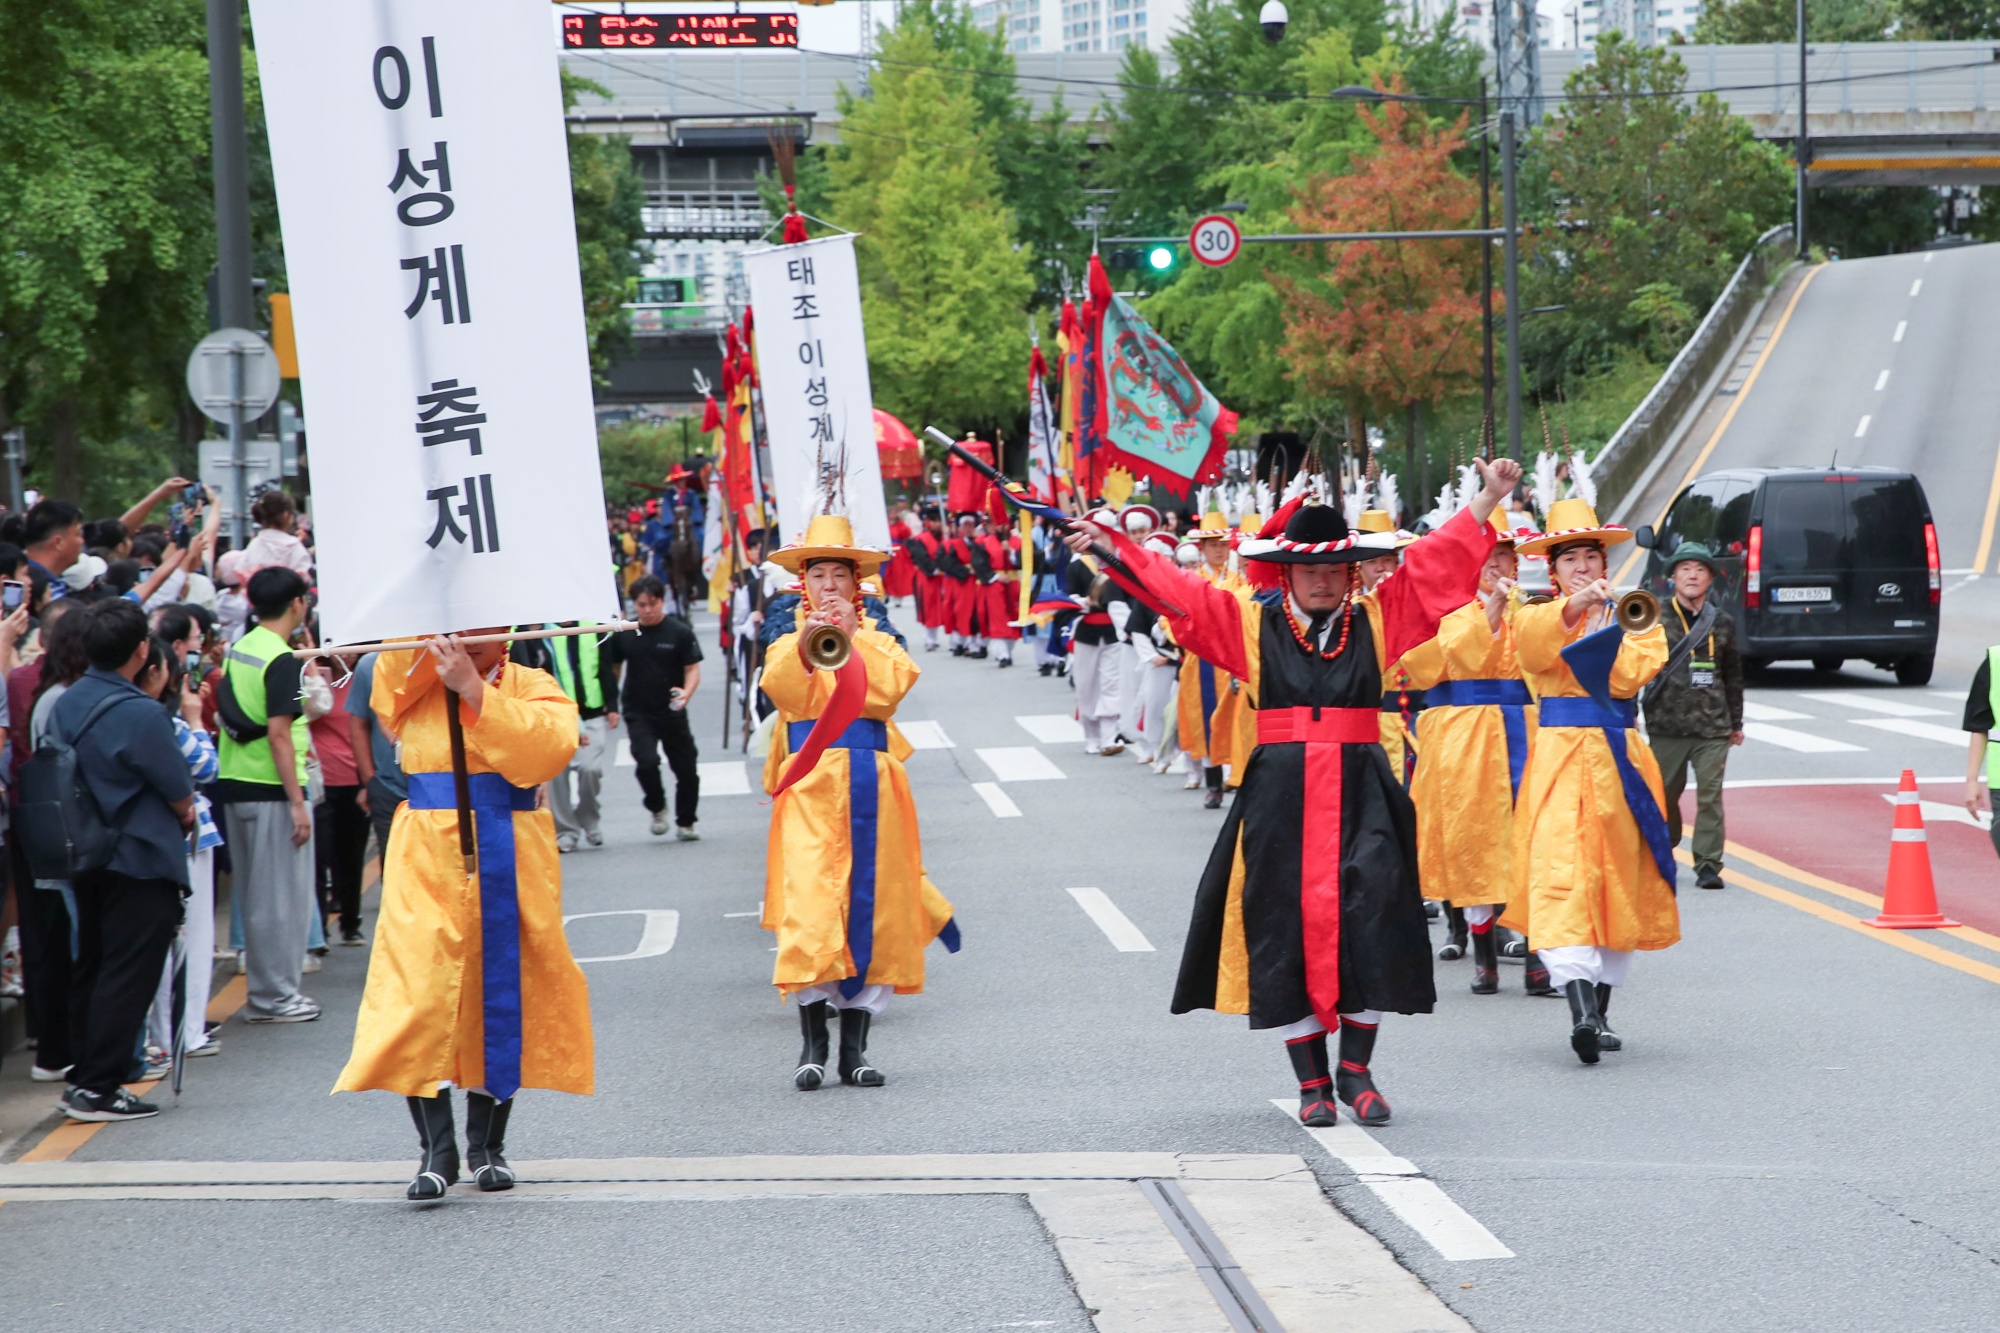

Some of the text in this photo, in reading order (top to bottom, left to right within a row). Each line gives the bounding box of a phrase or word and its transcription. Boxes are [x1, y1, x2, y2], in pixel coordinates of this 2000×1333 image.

[1201, 230, 1230, 252] 30
[372, 35, 501, 554] 이성계 축제
[787, 256, 820, 321] 태조
[798, 339, 835, 442] 이성계
